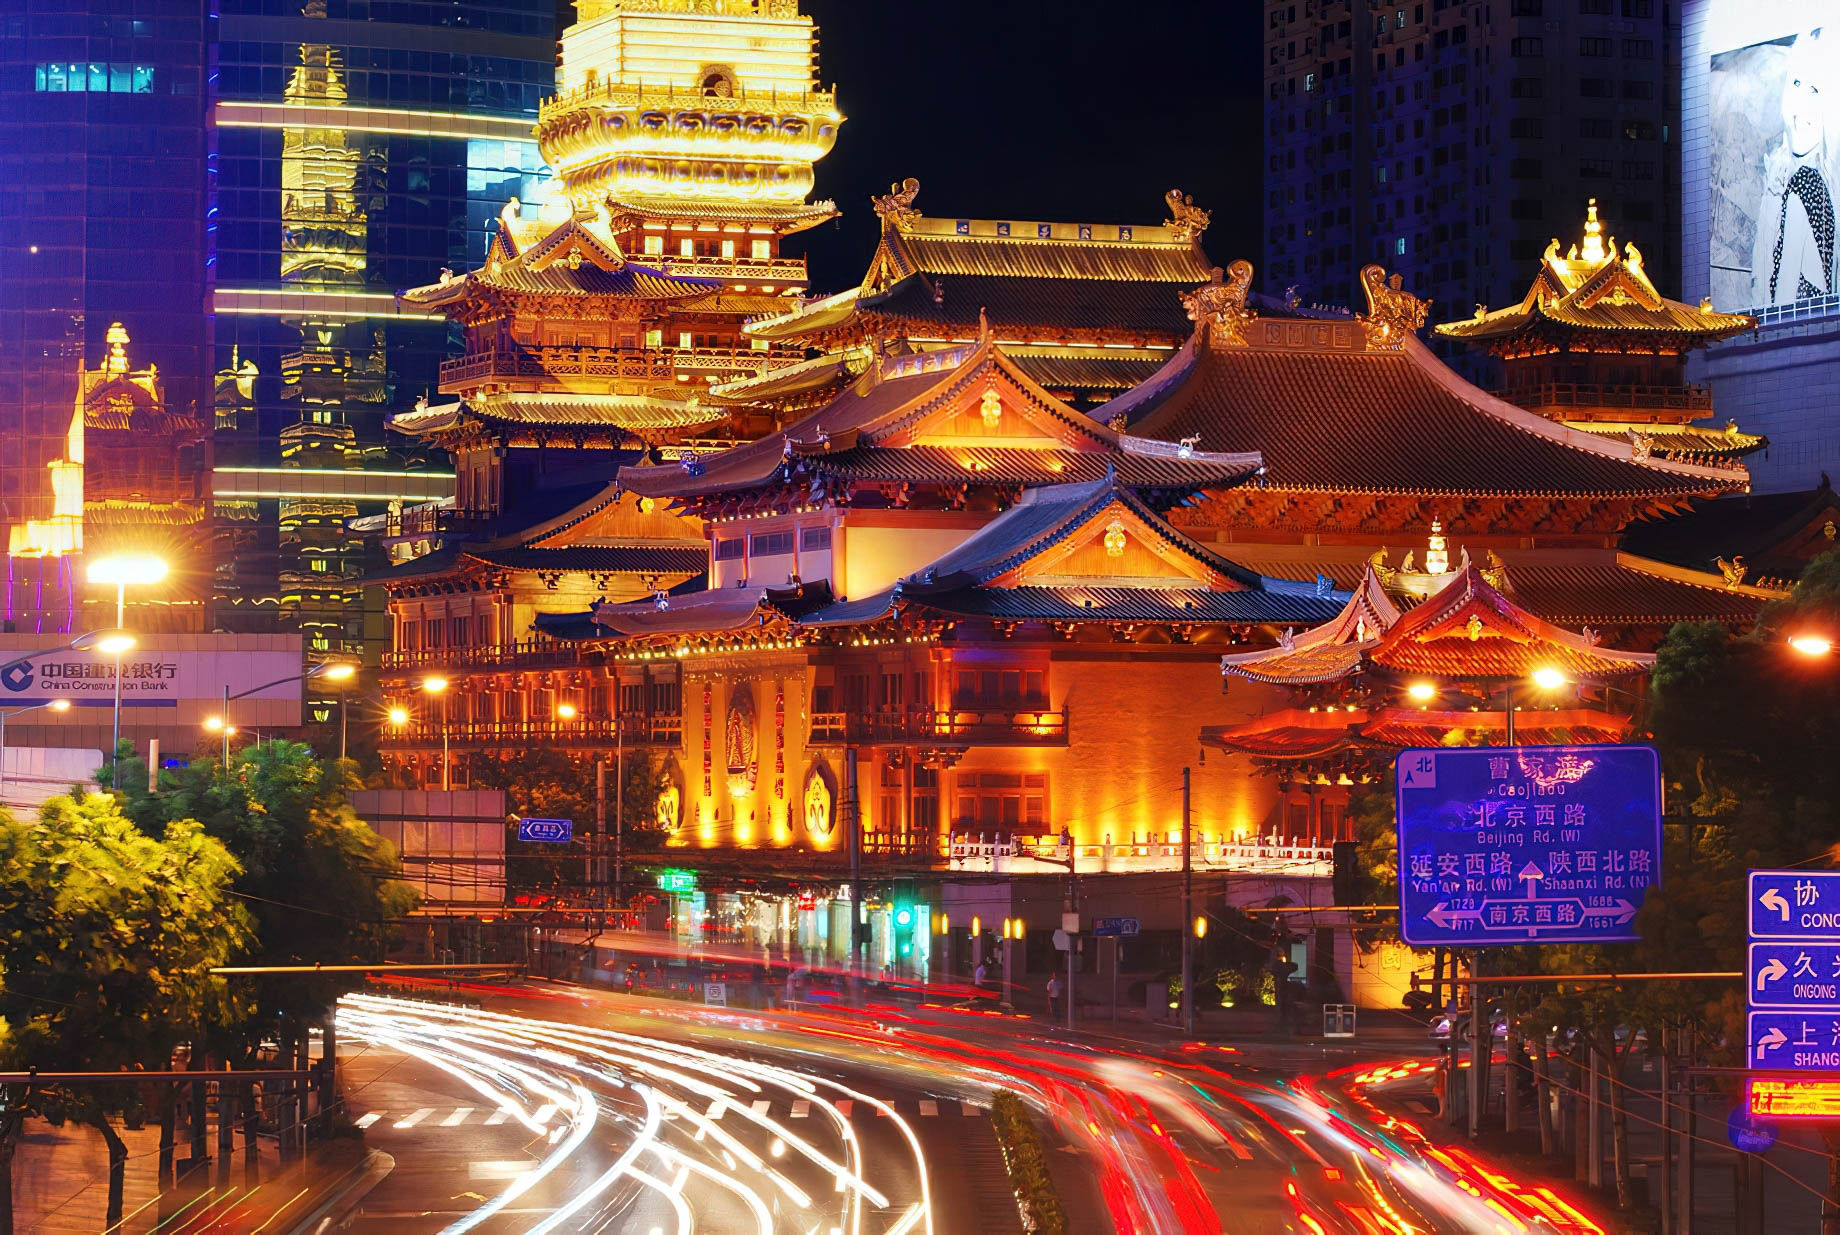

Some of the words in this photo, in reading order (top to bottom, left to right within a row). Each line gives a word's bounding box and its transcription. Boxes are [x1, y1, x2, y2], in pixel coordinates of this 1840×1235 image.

[41, 680, 71, 690] China
[72, 681, 138, 691] Construion
[141, 681, 168, 690] Bank
[1415, 756, 1433, 773] 北
[1498, 782, 1566, 800] Caojiadu
[1474, 802, 1586, 828] 北京西路
[1477, 831, 1523, 848] Beijing
[1533, 830, 1555, 843] Rd.
[1560, 829, 1580, 842] (W)
[1410, 851, 1513, 876] 延安西路
[1548, 849, 1652, 874] 陕西北路
[1412, 879, 1460, 894] Yan'an
[1466, 879, 1488, 892] Rd.
[1491, 878, 1512, 892] (W)
[1543, 876, 1597, 890] Shaanxi
[1604, 875, 1626, 889] Rd.
[1629, 875, 1650, 888] (N)
[1793, 879, 1820, 907] 协
[1489, 903, 1575, 924] 南京西路
[1589, 916, 1613, 928] 1661
[1793, 984, 1837, 999] ONGOING
[1793, 1052, 1840, 1067] SHANG
